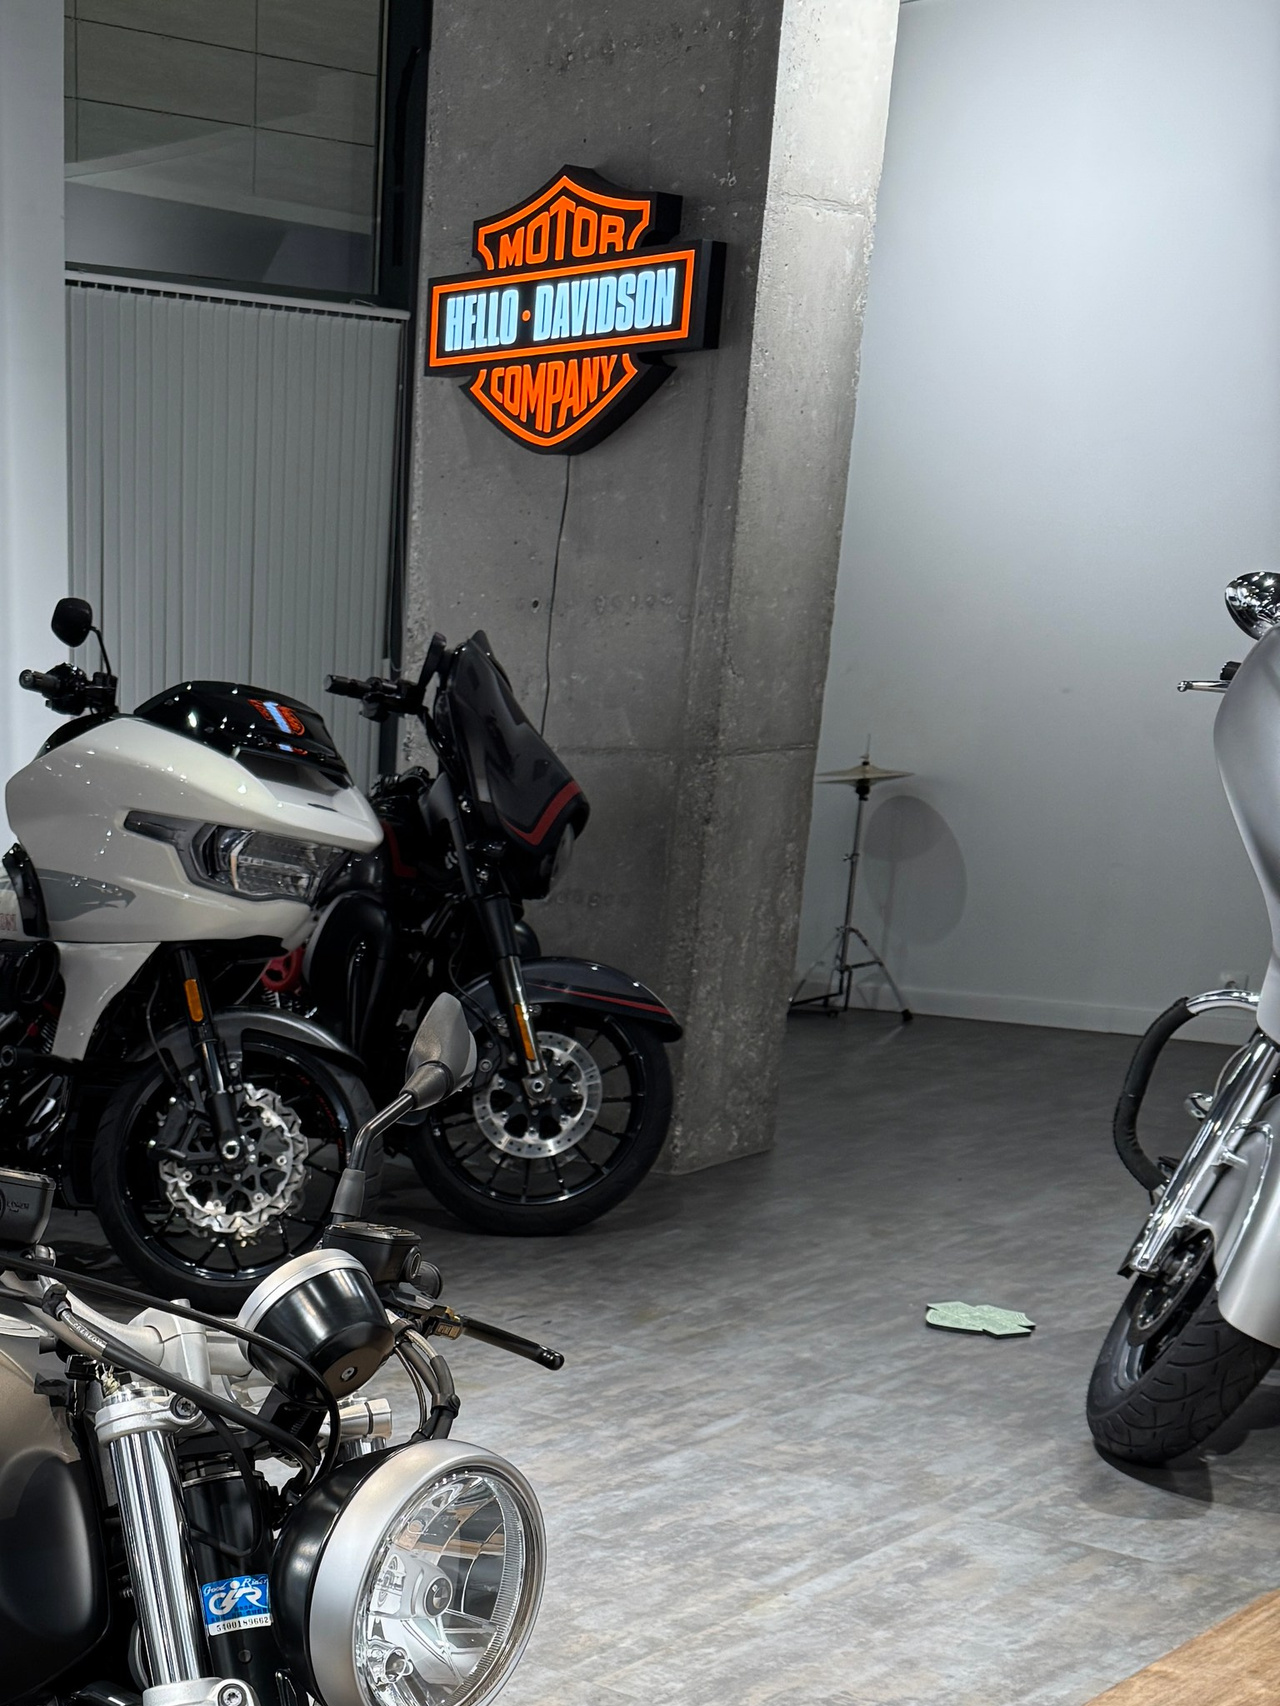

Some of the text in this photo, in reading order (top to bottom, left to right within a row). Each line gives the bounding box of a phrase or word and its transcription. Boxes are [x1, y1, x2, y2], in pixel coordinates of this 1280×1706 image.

[498, 195, 626, 269] MOTOR
[444, 267, 676, 352] HELLO DAVIDSON
[490, 354, 618, 433] COMPANY
